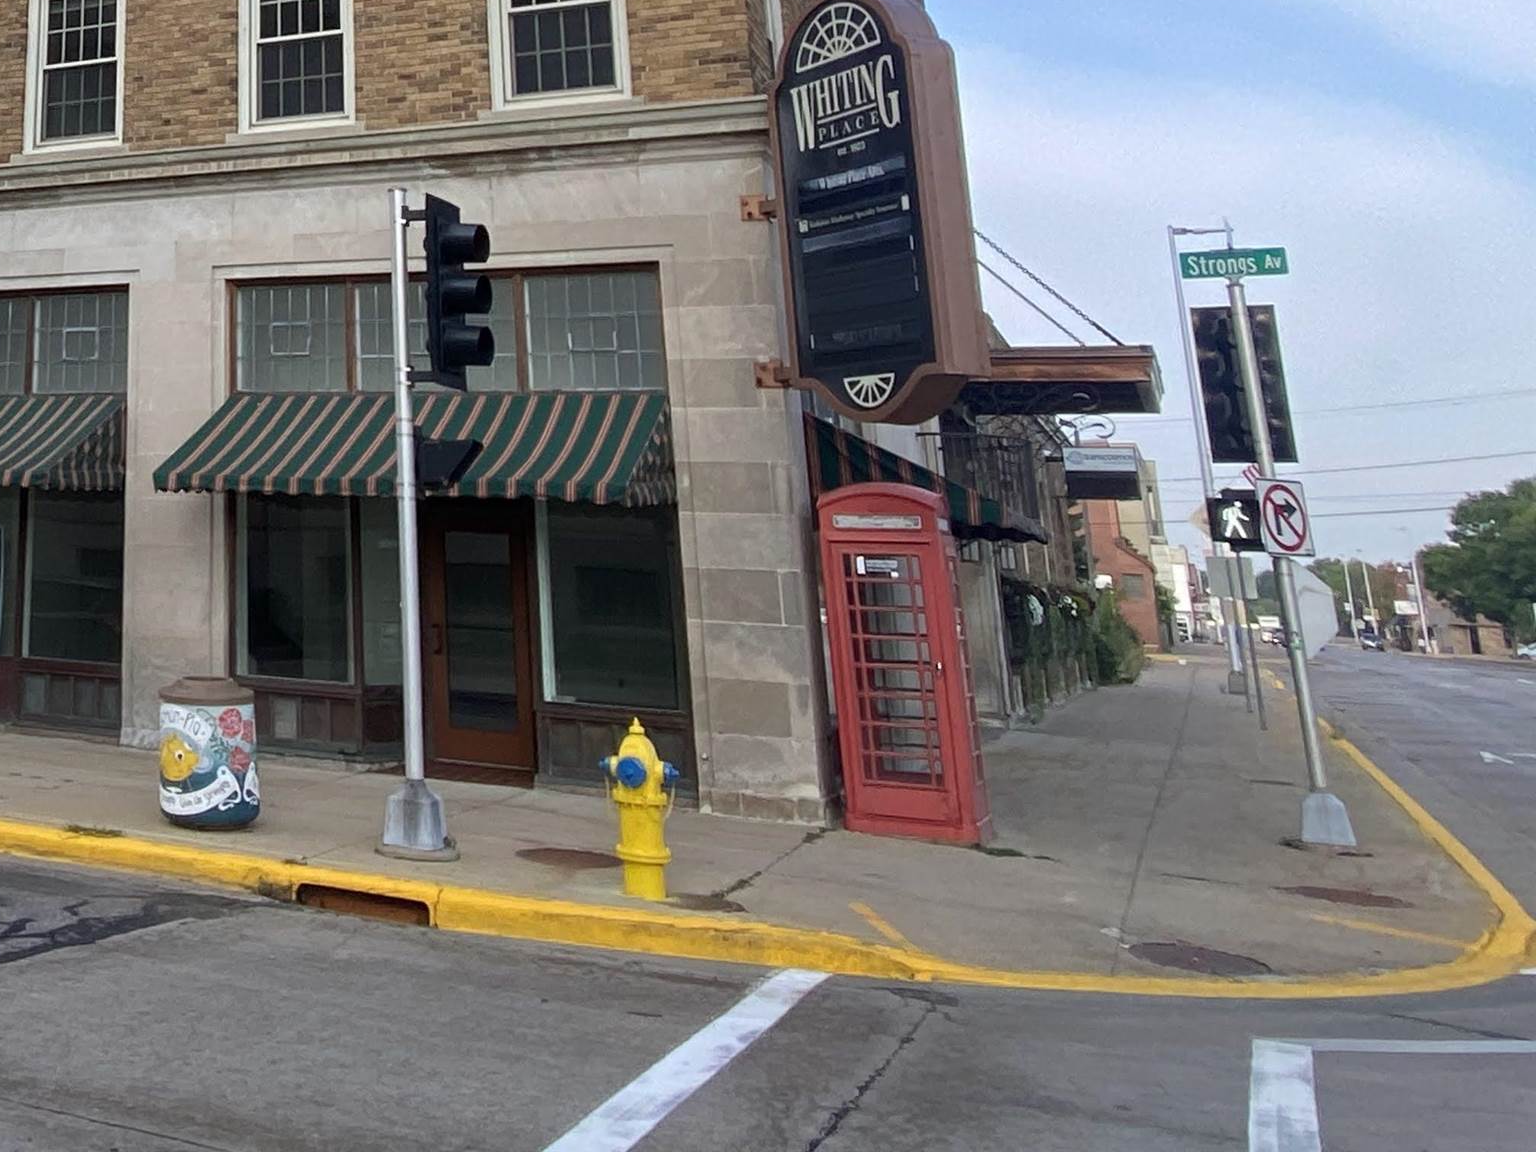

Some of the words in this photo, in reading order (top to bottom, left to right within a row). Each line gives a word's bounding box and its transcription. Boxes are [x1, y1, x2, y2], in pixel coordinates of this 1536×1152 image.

[790, 54, 901, 152] WHITING
[818, 111, 880, 142] PLACE
[1187, 256, 1258, 276] Strongs
[1264, 254, 1282, 269] Av
